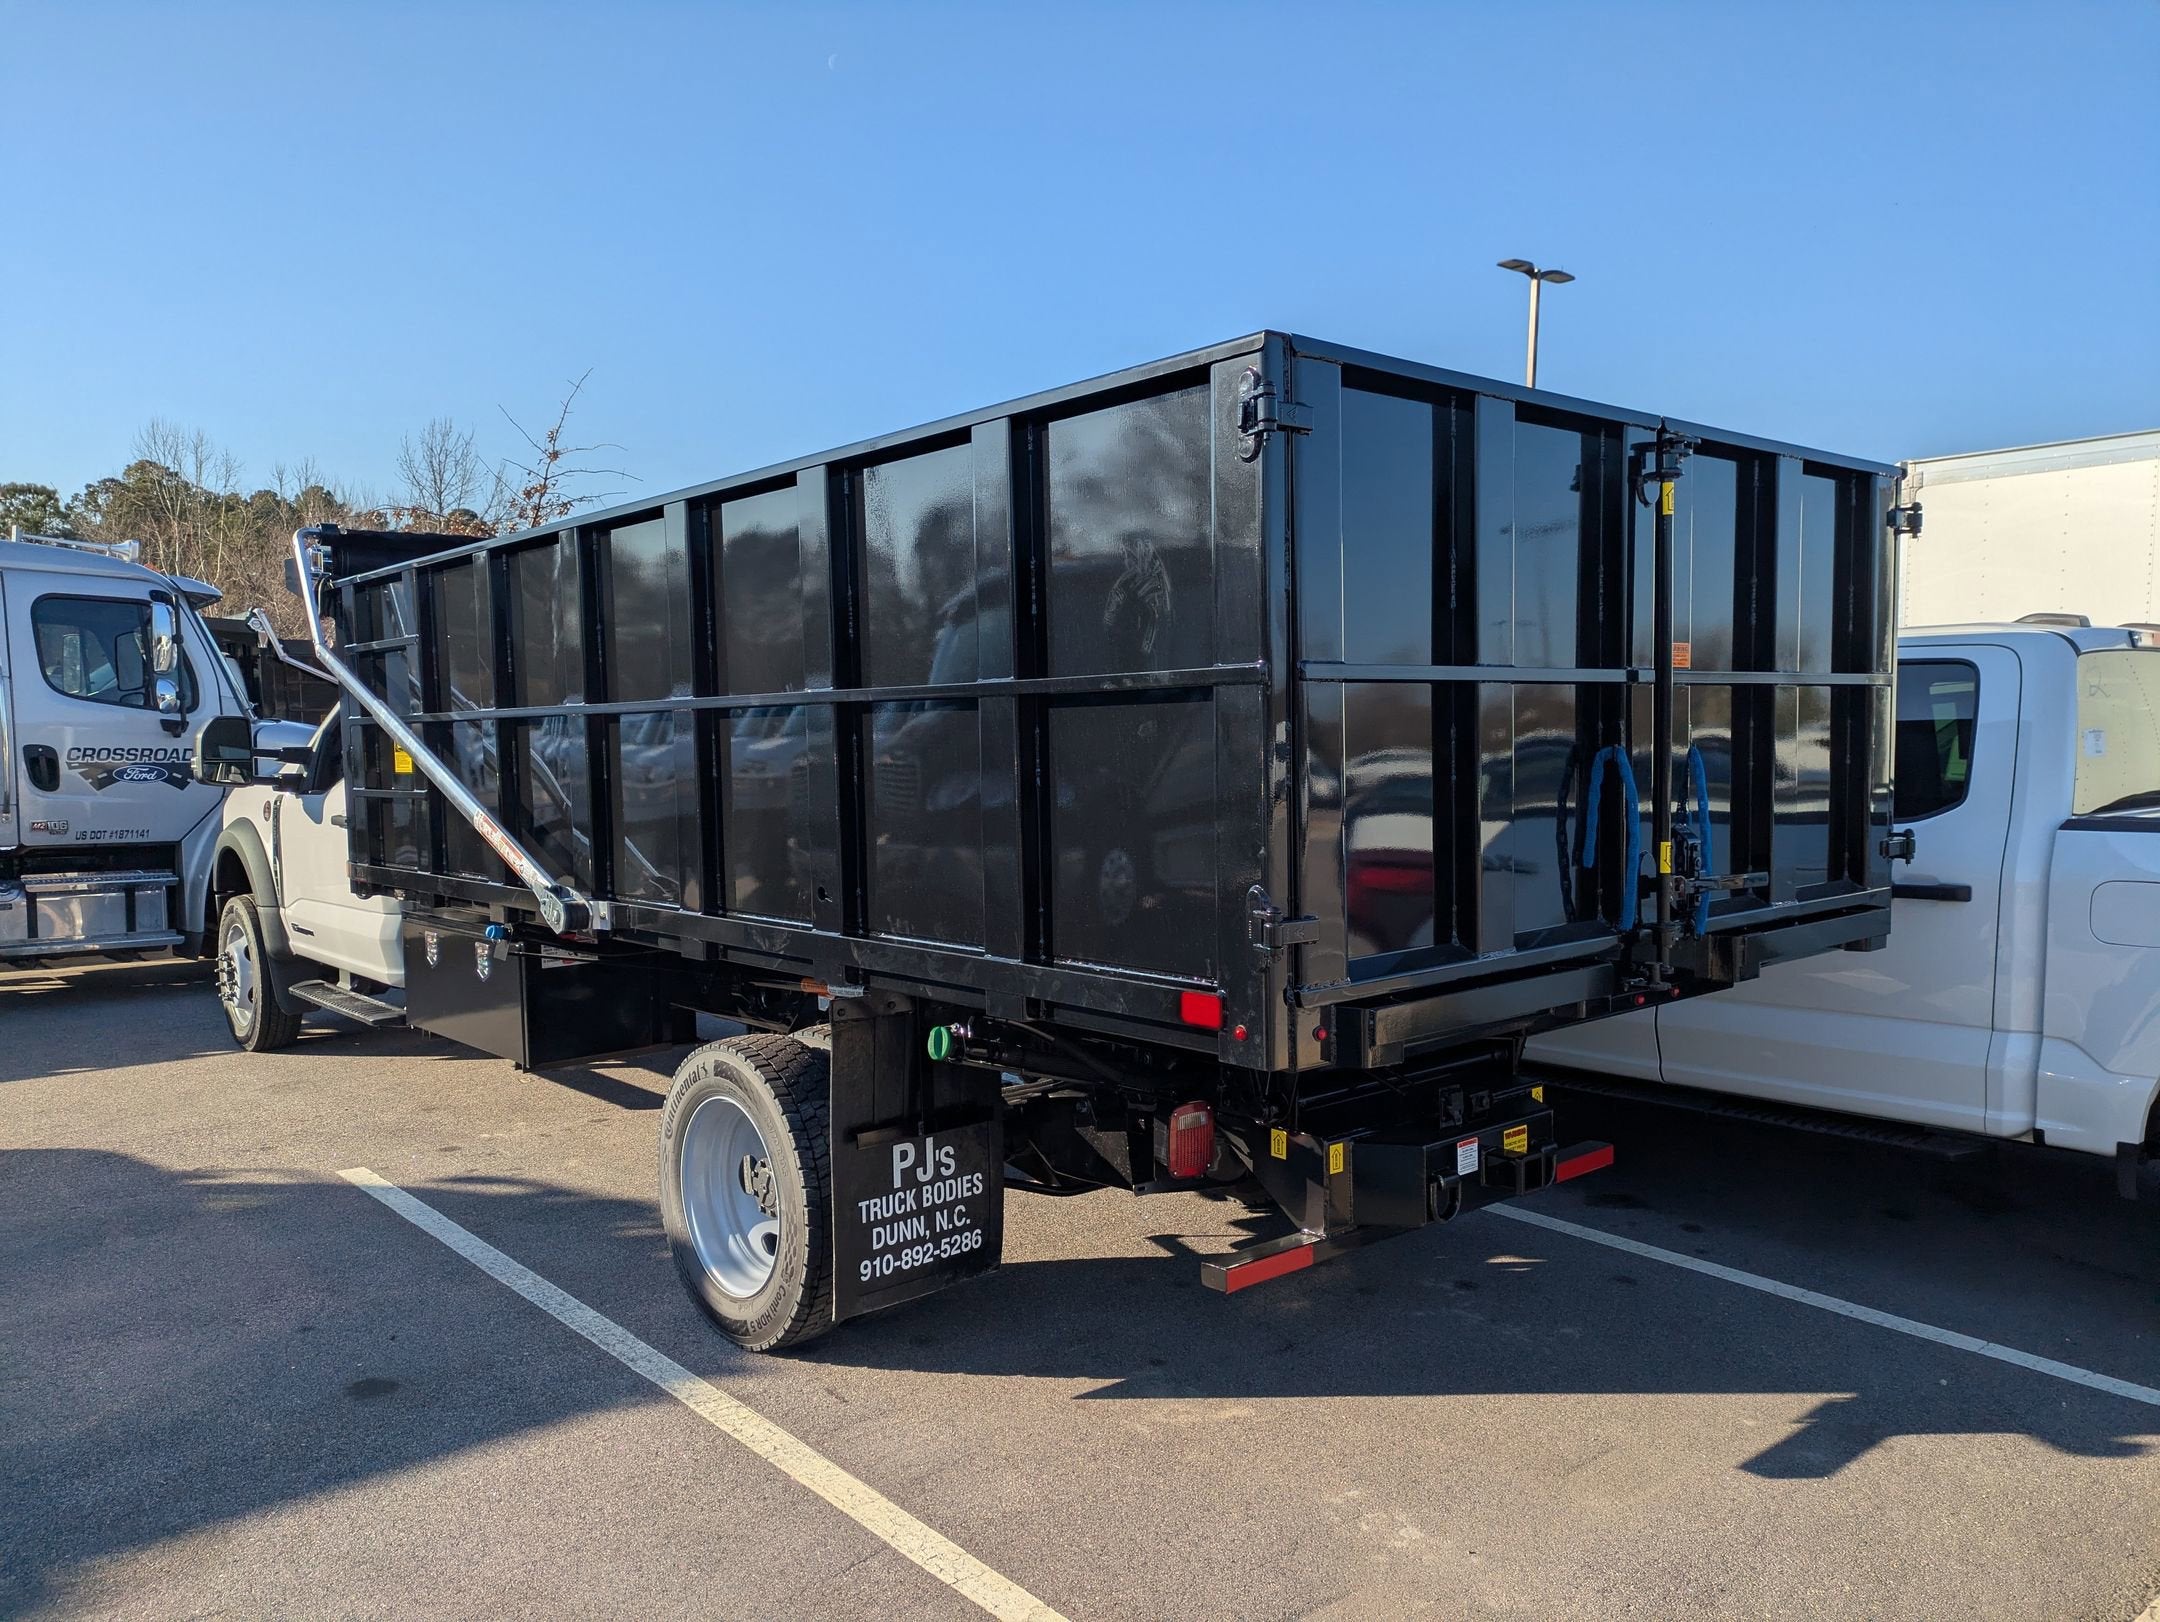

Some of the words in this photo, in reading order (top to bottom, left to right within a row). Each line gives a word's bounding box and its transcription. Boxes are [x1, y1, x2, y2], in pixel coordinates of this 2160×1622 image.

[123, 767, 158, 781] Ford
[75, 830, 88, 840] US
[89, 829, 107, 840] DOT
[109, 829, 150, 840] #1871141
[858, 1188, 917, 1224] TRUCK
[922, 1172, 983, 1208] BODIES
[872, 1215, 930, 1250] DUNN,
[935, 1204, 971, 1233] N.C.
[859, 1228, 982, 1282] 910-892-5286
[769, 1285, 787, 1317] Conti
[755, 1309, 773, 1330] HDR
